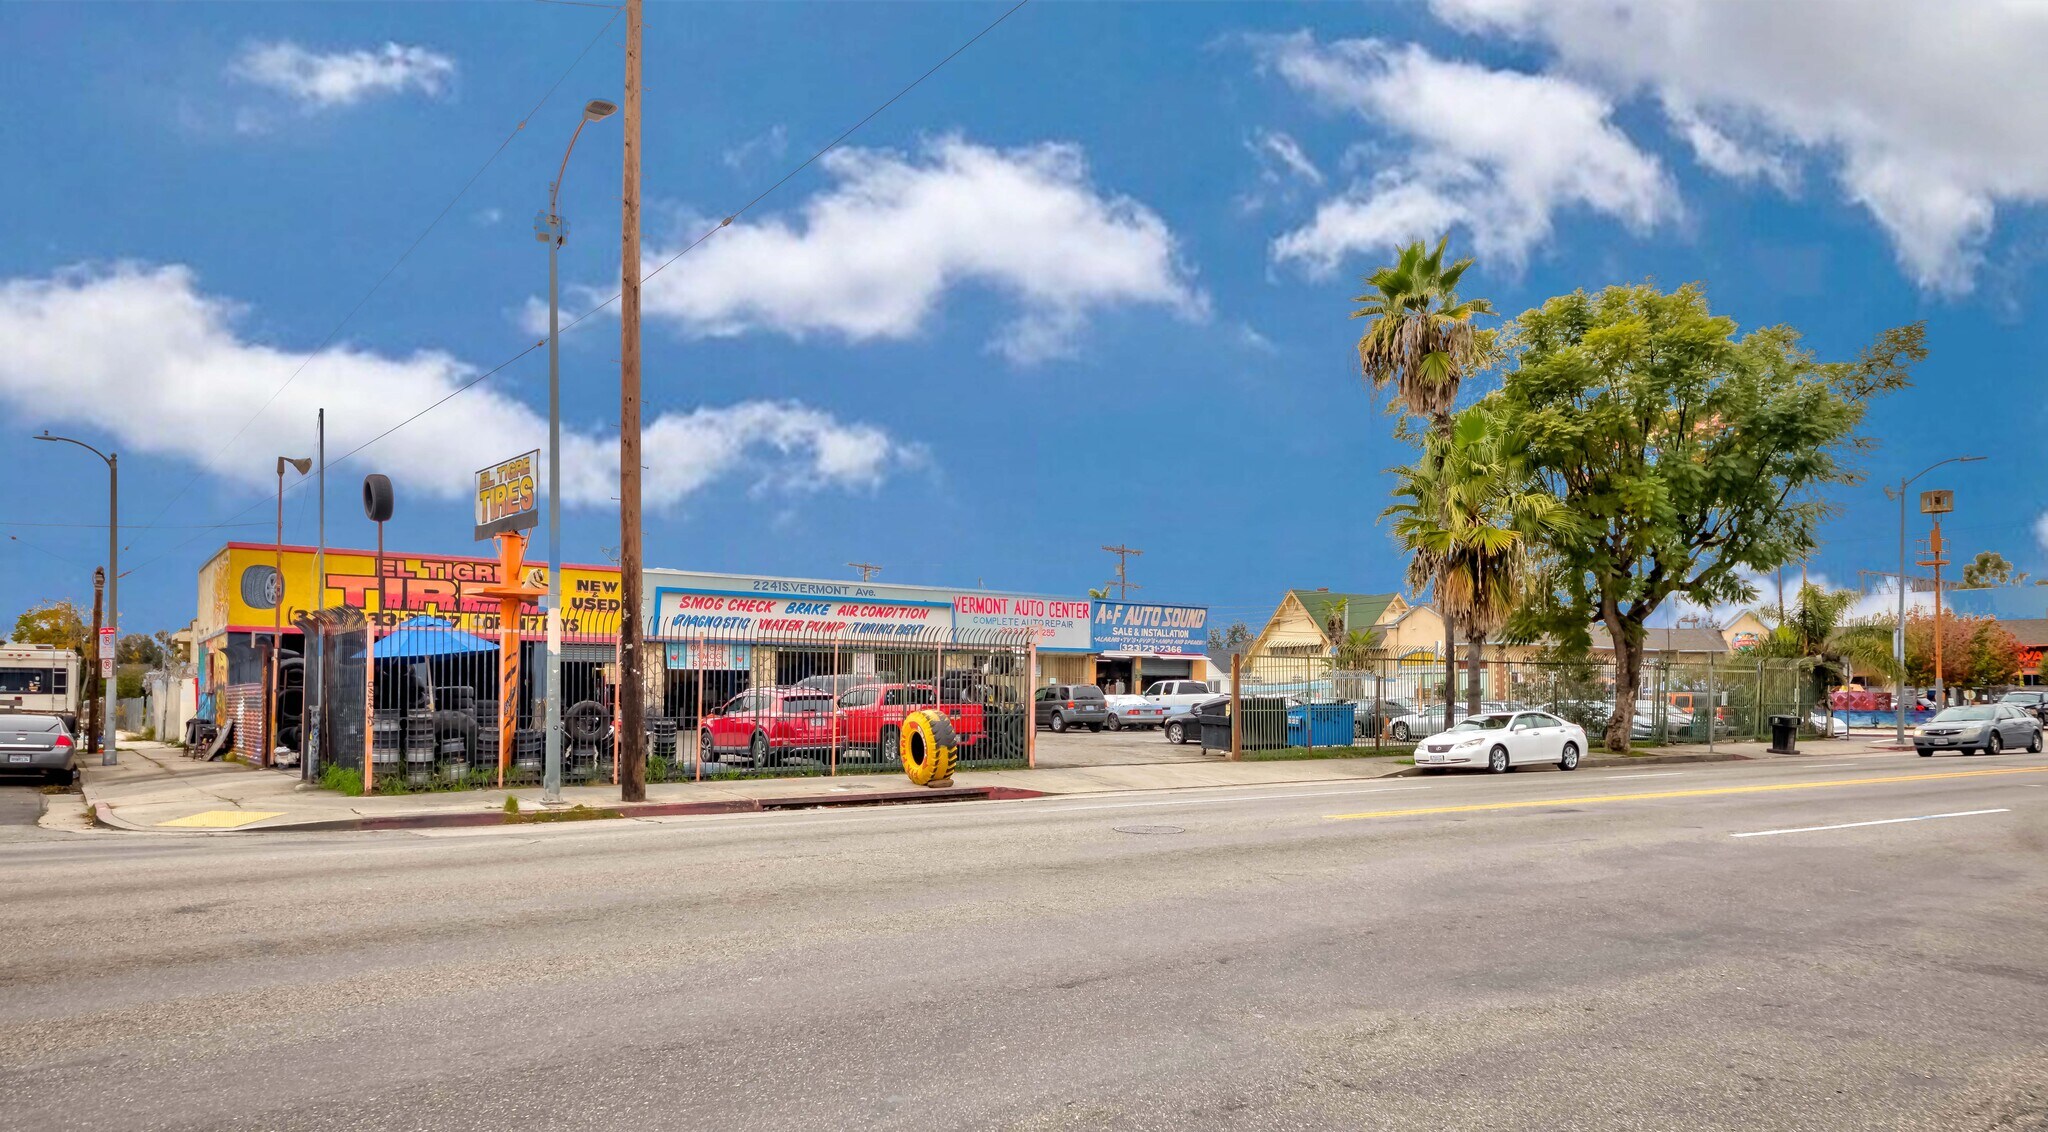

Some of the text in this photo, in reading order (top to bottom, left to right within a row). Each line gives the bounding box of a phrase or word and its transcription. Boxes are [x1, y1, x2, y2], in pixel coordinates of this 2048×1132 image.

[480, 456, 530, 490] EL TIGRE
[480, 475, 534, 524] TIRES
[375, 558, 417, 578] EL
[576, 579, 619, 593] NEW
[855, 588, 876, 597] Ave.
[571, 597, 621, 613] USED
[679, 595, 930, 620] SMOG CHECK BRAKE AIR CONDITION
[953, 595, 1090, 619] VERMONT AUTO CENTER
[673, 613, 925, 636] DIAGNOSTIC WATER PUMP TIMING BELT
[973, 616, 1019, 626] COMPLETE
[1094, 603, 1207, 629] A&F AUTO SOUND
[1112, 626, 1189, 639] SALE & INSTALLATION
